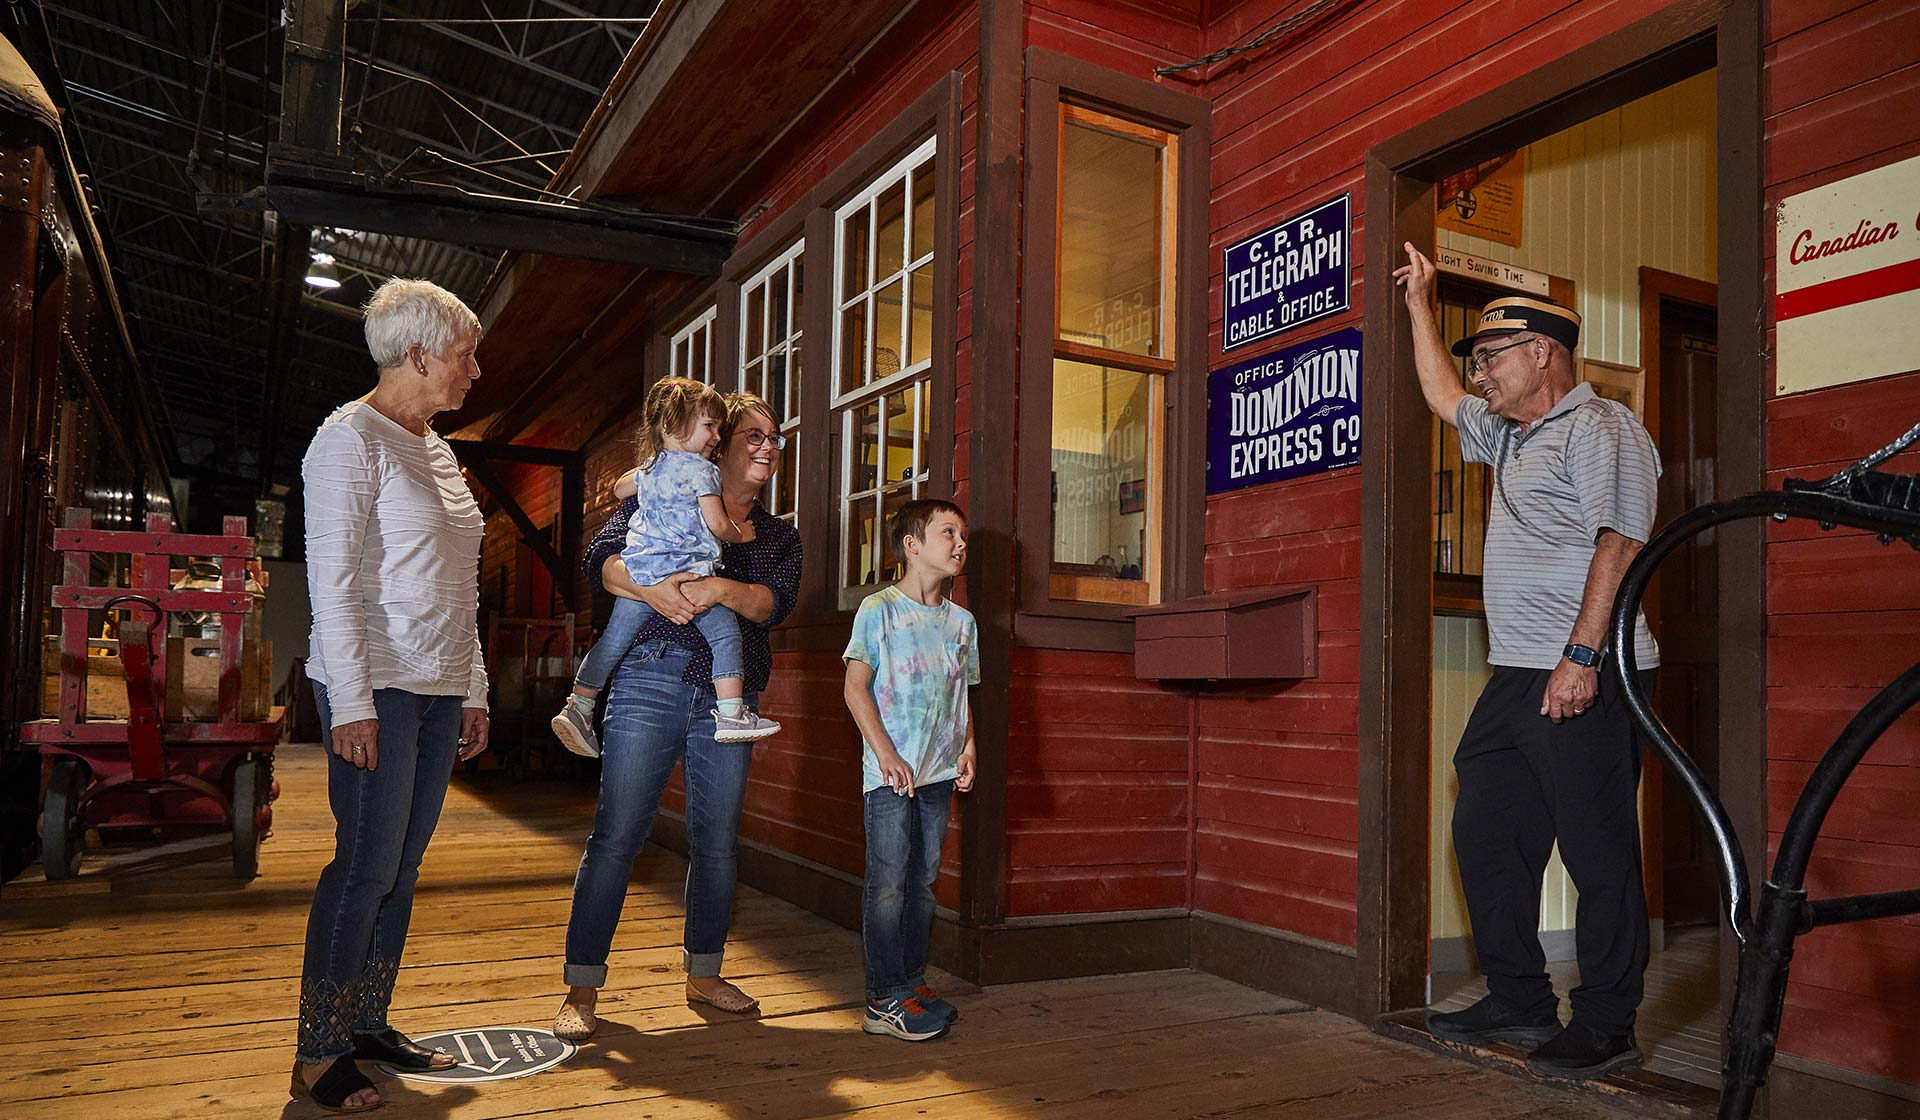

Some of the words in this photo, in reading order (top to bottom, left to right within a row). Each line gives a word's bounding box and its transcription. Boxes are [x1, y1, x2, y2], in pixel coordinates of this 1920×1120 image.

[1249, 242, 1269, 262] C.
[1274, 230, 1291, 253] P.
[1300, 219, 1322, 242] R.
[1790, 219, 1899, 265] Canadian
[1228, 230, 1341, 307] TELEGRAPH
[1467, 258, 1499, 277] SAVING
[1504, 268, 1524, 284] TIME
[1230, 308, 1274, 342] CABLE
[1281, 286, 1339, 324] OFFICE.
[1277, 291, 1285, 303] &
[1229, 349, 1360, 437] DOMINION
[1235, 360, 1284, 386] OFFICE
[1230, 424, 1322, 479] EXPRESS
